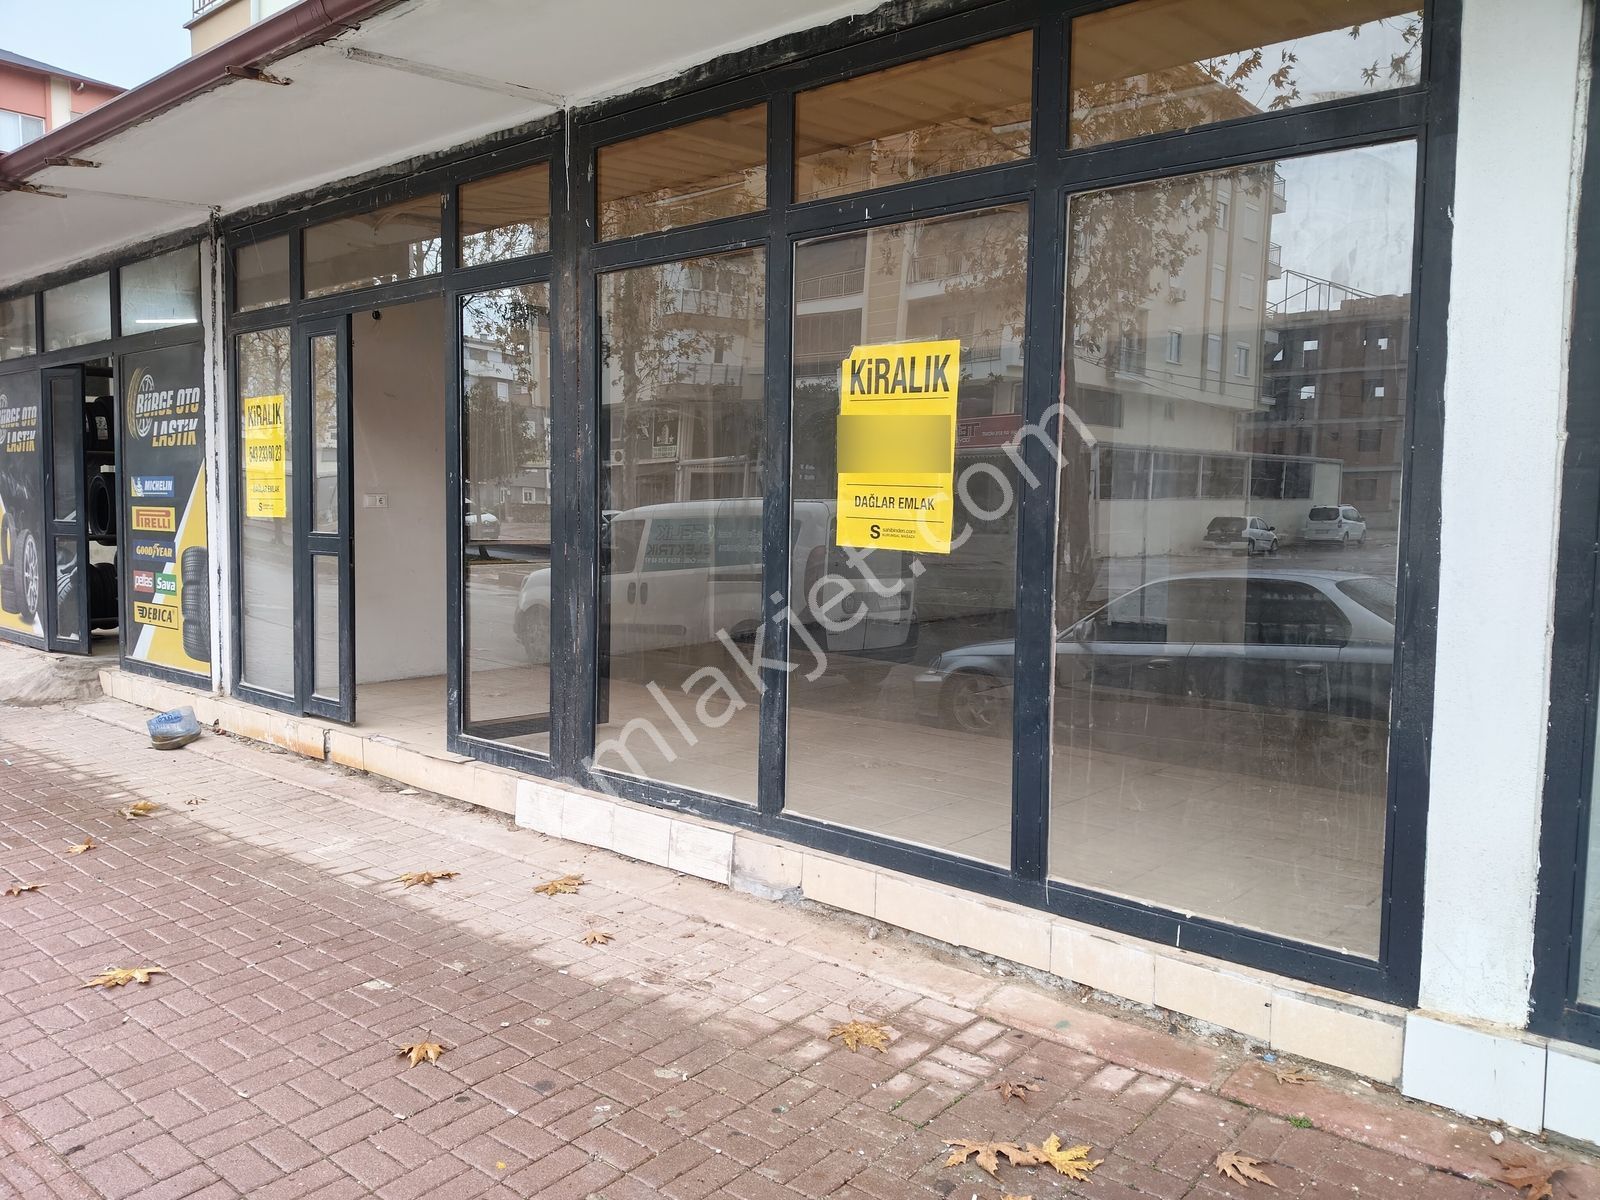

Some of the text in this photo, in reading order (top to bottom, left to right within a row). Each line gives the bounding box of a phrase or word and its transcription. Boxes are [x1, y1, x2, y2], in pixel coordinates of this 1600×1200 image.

[176, 387, 200, 414] OTO
[22, 406, 37, 427] OTO
[144, 480, 173, 491] MICHELIN
[854, 493, 935, 511] DAĞLAR EMLAK
[135, 508, 171, 529] PIRELLI
[870, 524, 881, 539] S
[136, 543, 173, 559] GOODYEAR
[156, 577, 176, 591] Sava
